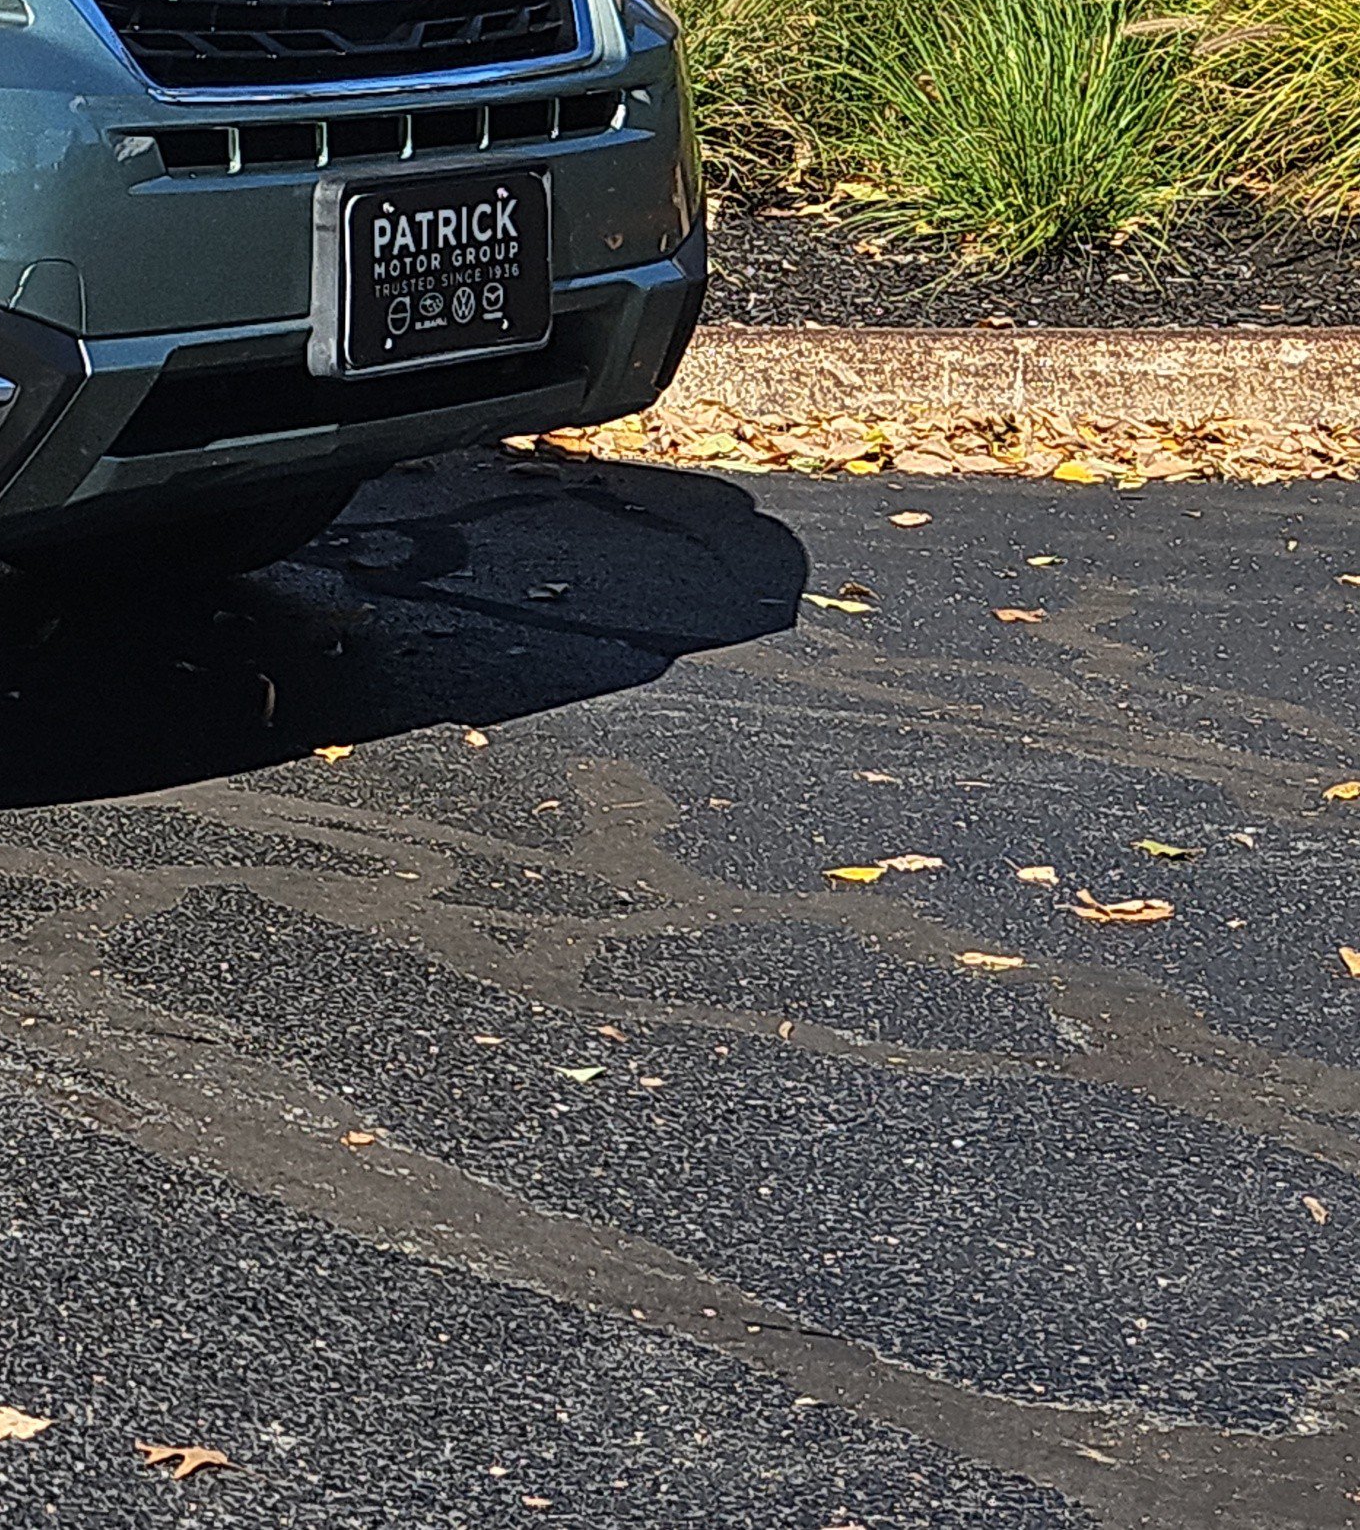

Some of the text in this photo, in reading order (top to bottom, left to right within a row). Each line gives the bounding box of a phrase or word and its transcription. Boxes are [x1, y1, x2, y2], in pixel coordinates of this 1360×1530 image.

[373, 199, 518, 258] PATRICK
[374, 241, 519, 280] MOTOR GROUP
[375, 263, 520, 298] TRUSTED SINCE 1936
